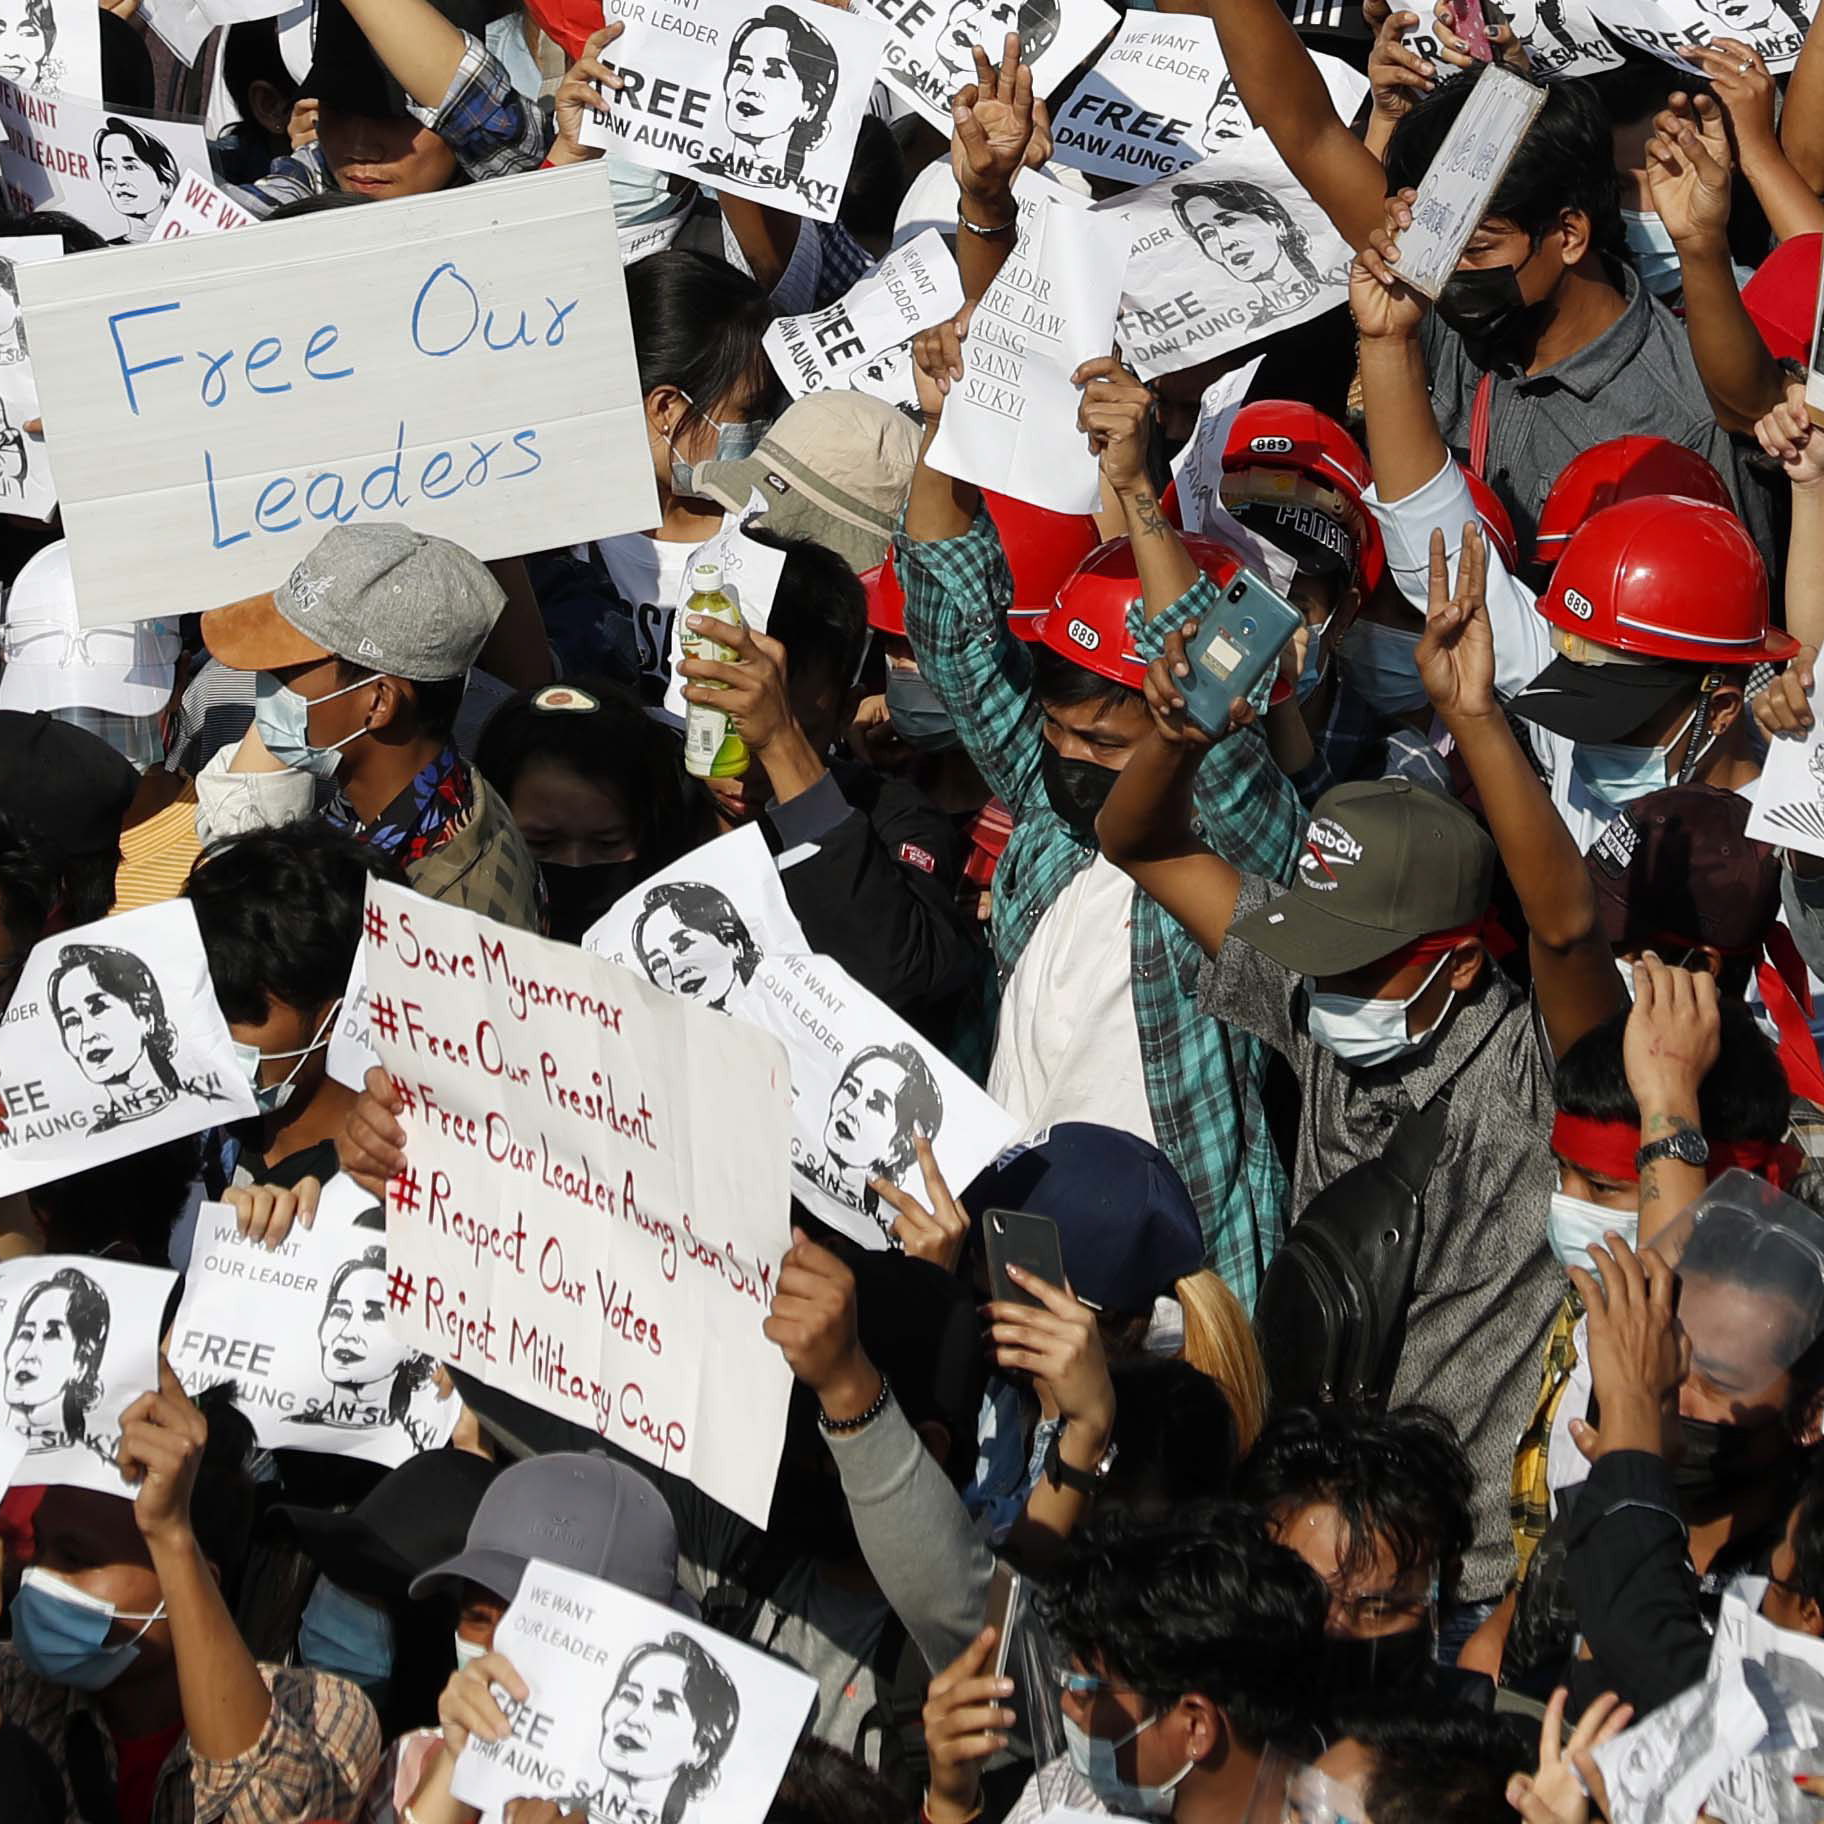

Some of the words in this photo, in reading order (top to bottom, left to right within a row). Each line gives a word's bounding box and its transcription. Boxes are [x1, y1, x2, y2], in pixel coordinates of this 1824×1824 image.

[650, 6, 720, 47] LEADER
[591, 110, 640, 145] DAW
[638, 123, 707, 162] AUNG
[710, 144, 756, 179] SAN
[107, 301, 355, 415] Free
[412, 262, 578, 357] Our
[204, 423, 543, 551] Leaders
[1257, 438, 1287, 452] 889
[1071, 622, 1097, 645] 889
[1567, 591, 1590, 616] 889
[397, 914, 477, 974] Save
[481, 936, 624, 1034] Myanmar
[370, 997, 469, 1067] #Free
[475, 1023, 530, 1086] Our
[540, 1050, 655, 1149] President
[427, 1177, 526, 1273] Respect
[538, 1243, 586, 1302] Our
[595, 1277, 662, 1355] Votes
[423, 1278, 497, 1357] Reject
[509, 1323, 614, 1431] Military
[620, 1384, 686, 1471] Coup
